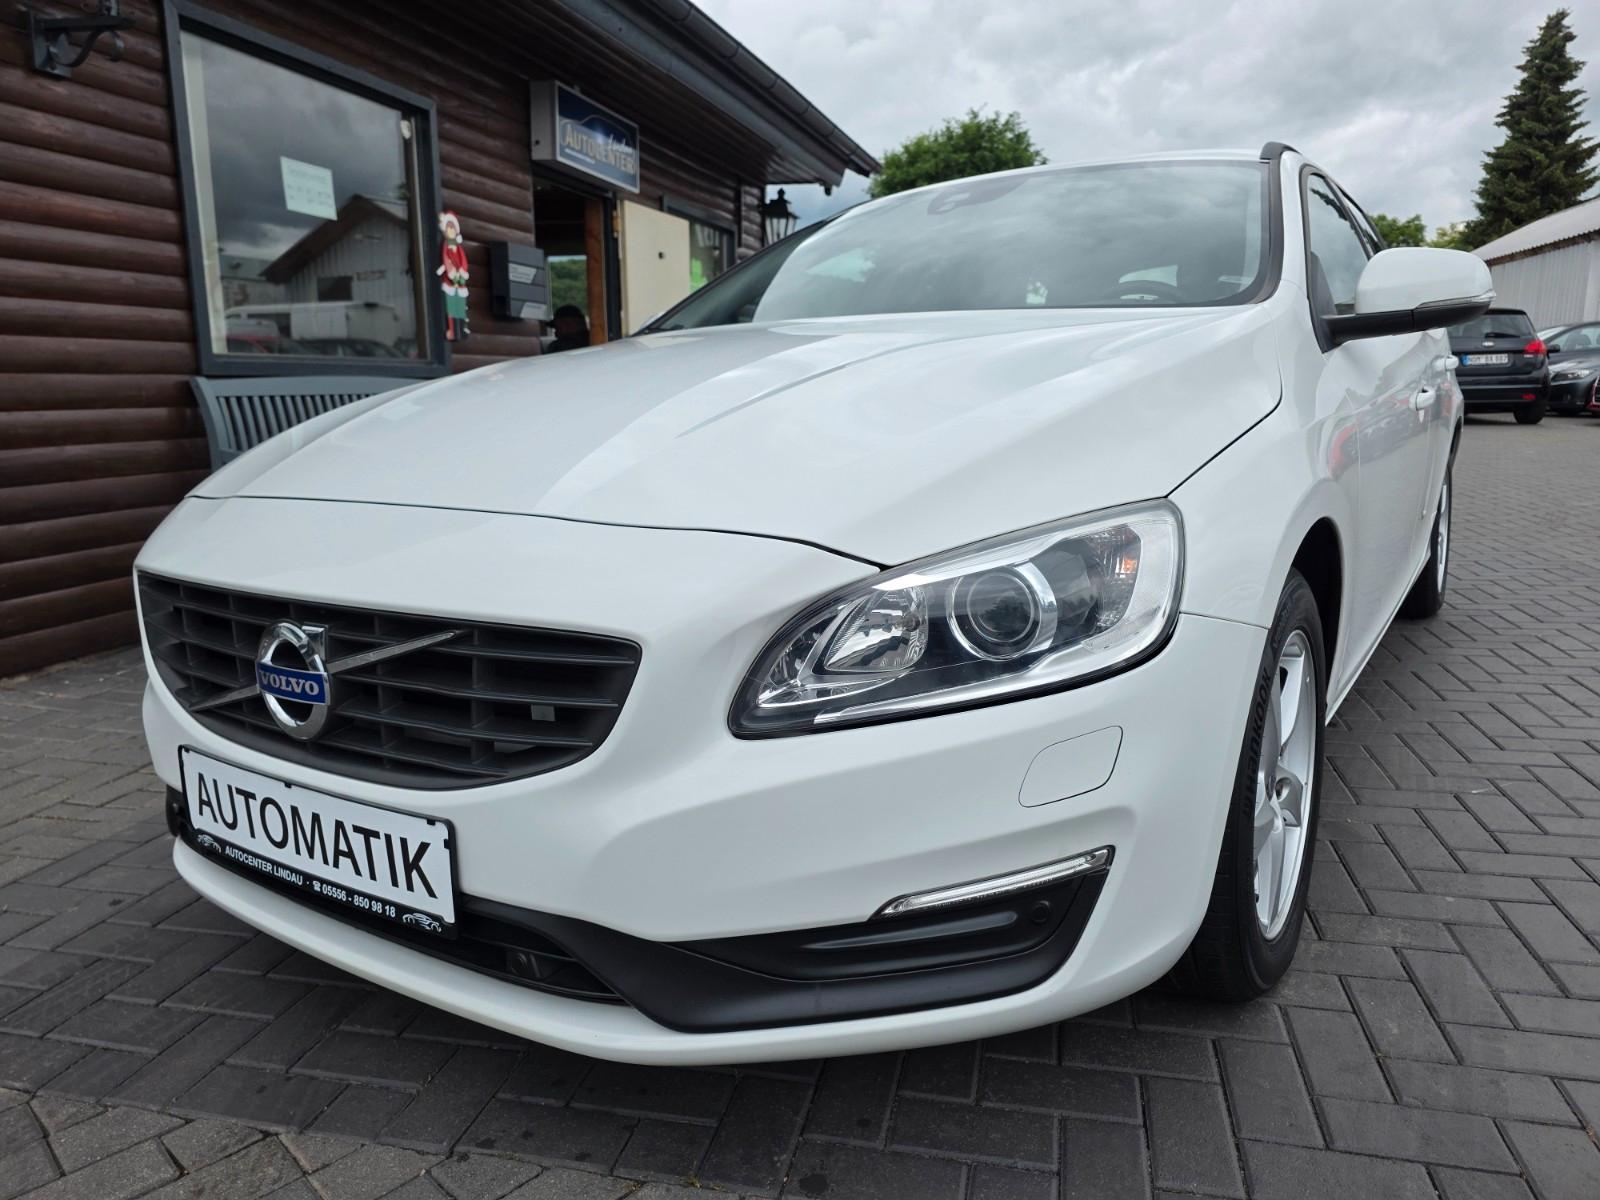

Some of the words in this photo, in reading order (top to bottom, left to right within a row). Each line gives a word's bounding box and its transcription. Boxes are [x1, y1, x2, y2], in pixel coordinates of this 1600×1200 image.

[259, 670, 320, 696] VOLVO
[197, 772, 438, 900] AUTOMATIK
[224, 845, 273, 874] AUTOCENTER
[273, 865, 303, 886] LINDAU
[322, 884, 347, 901] 05556
[353, 894, 369, 910] 850
[371, 901, 383, 914] 98
[384, 904, 396, 918] 18
